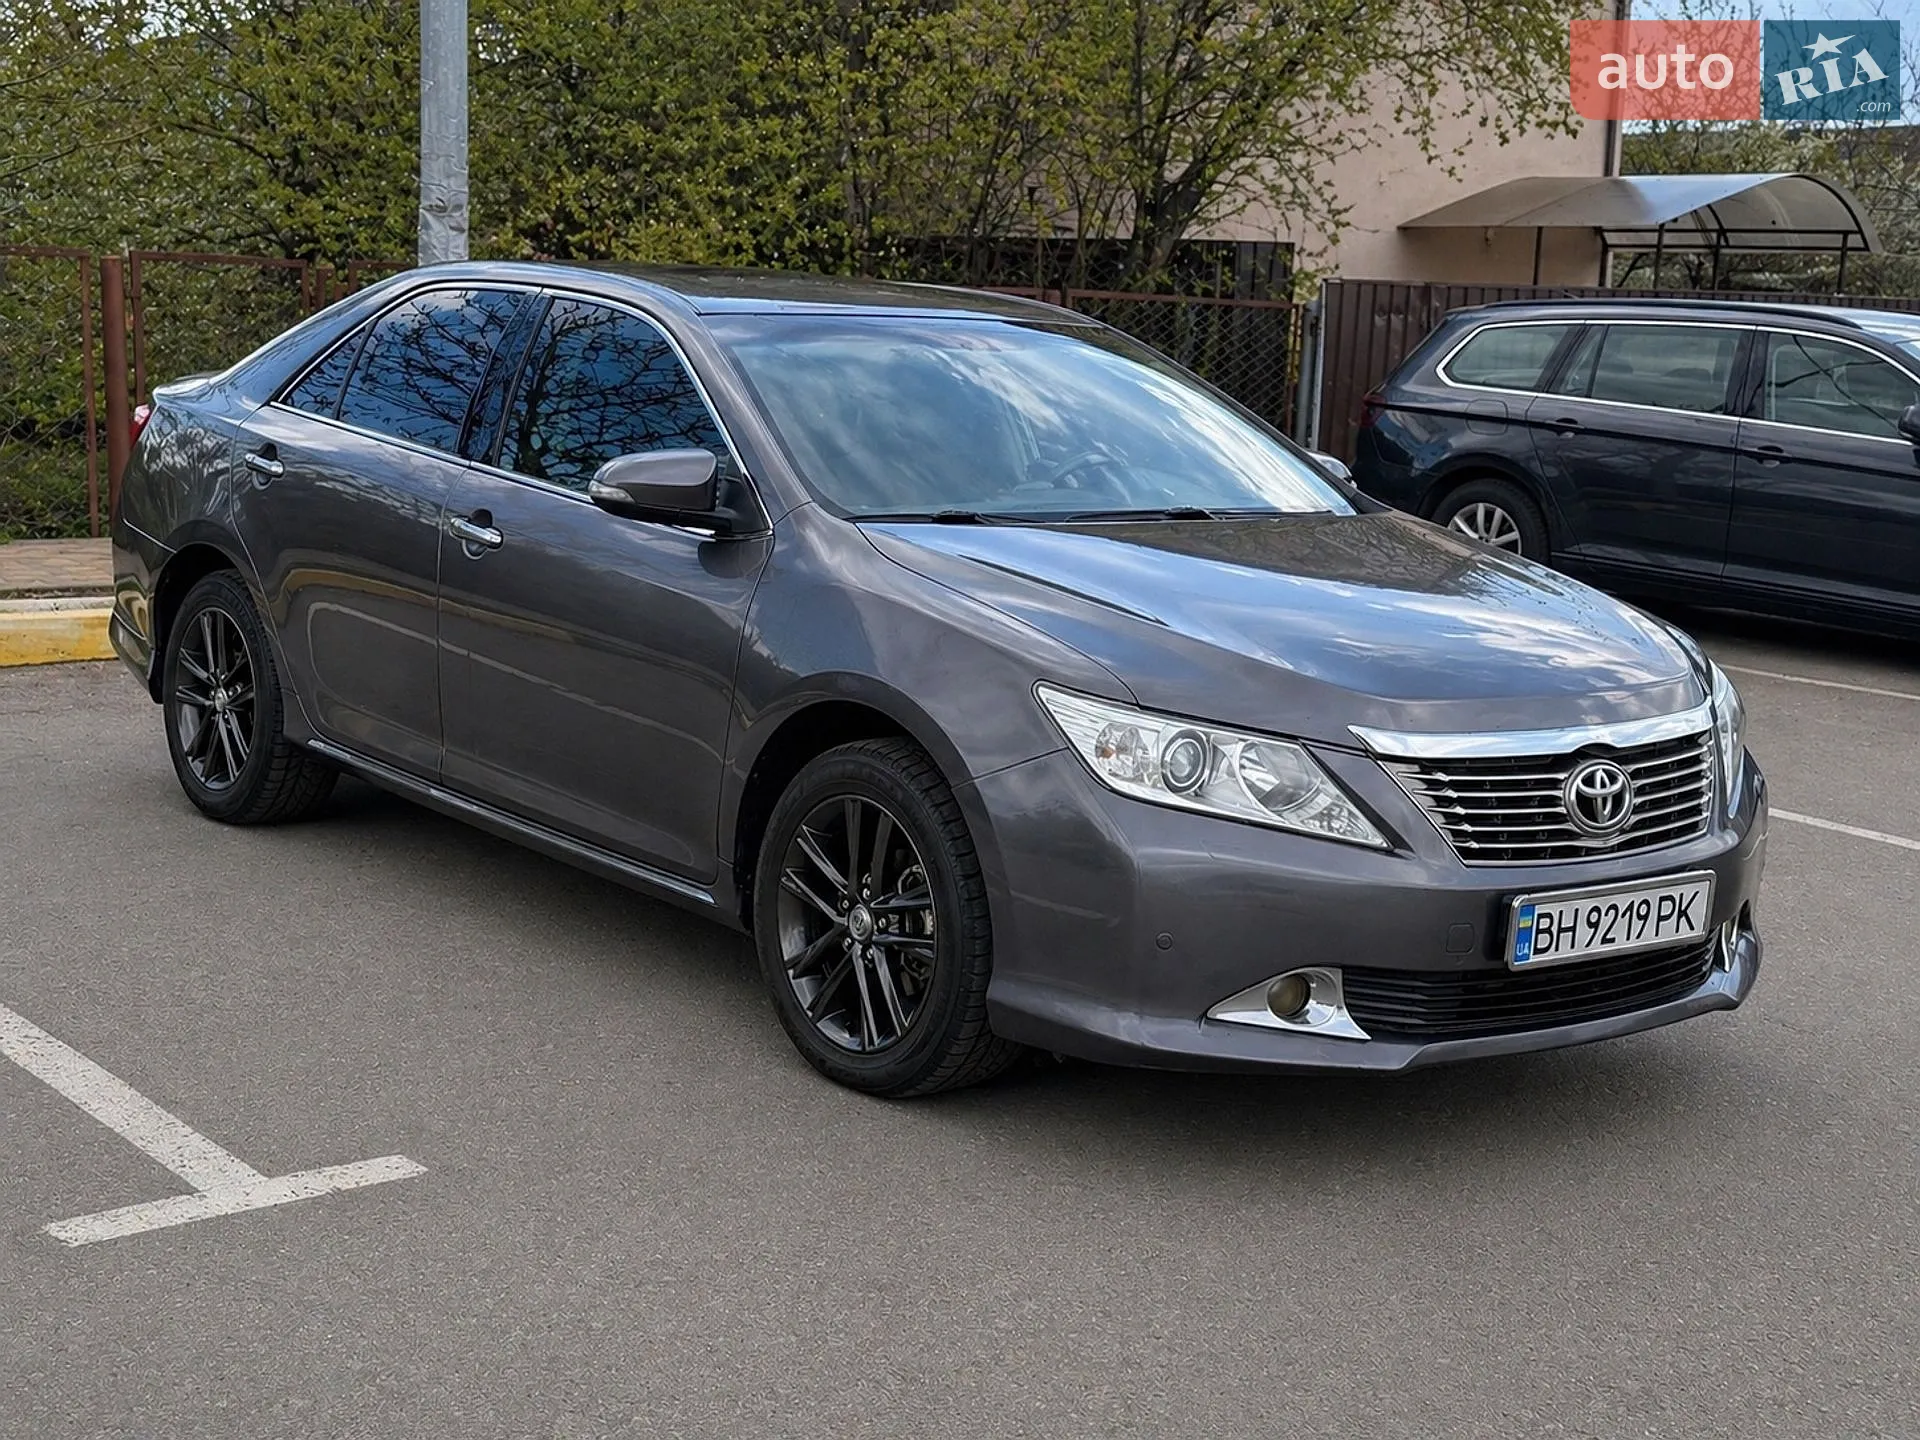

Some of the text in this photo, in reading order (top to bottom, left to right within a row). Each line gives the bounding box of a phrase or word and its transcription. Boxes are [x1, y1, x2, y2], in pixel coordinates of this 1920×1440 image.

[1533, 890, 1700, 956] BH 9219 PK
[1517, 942, 1529, 955] UA
